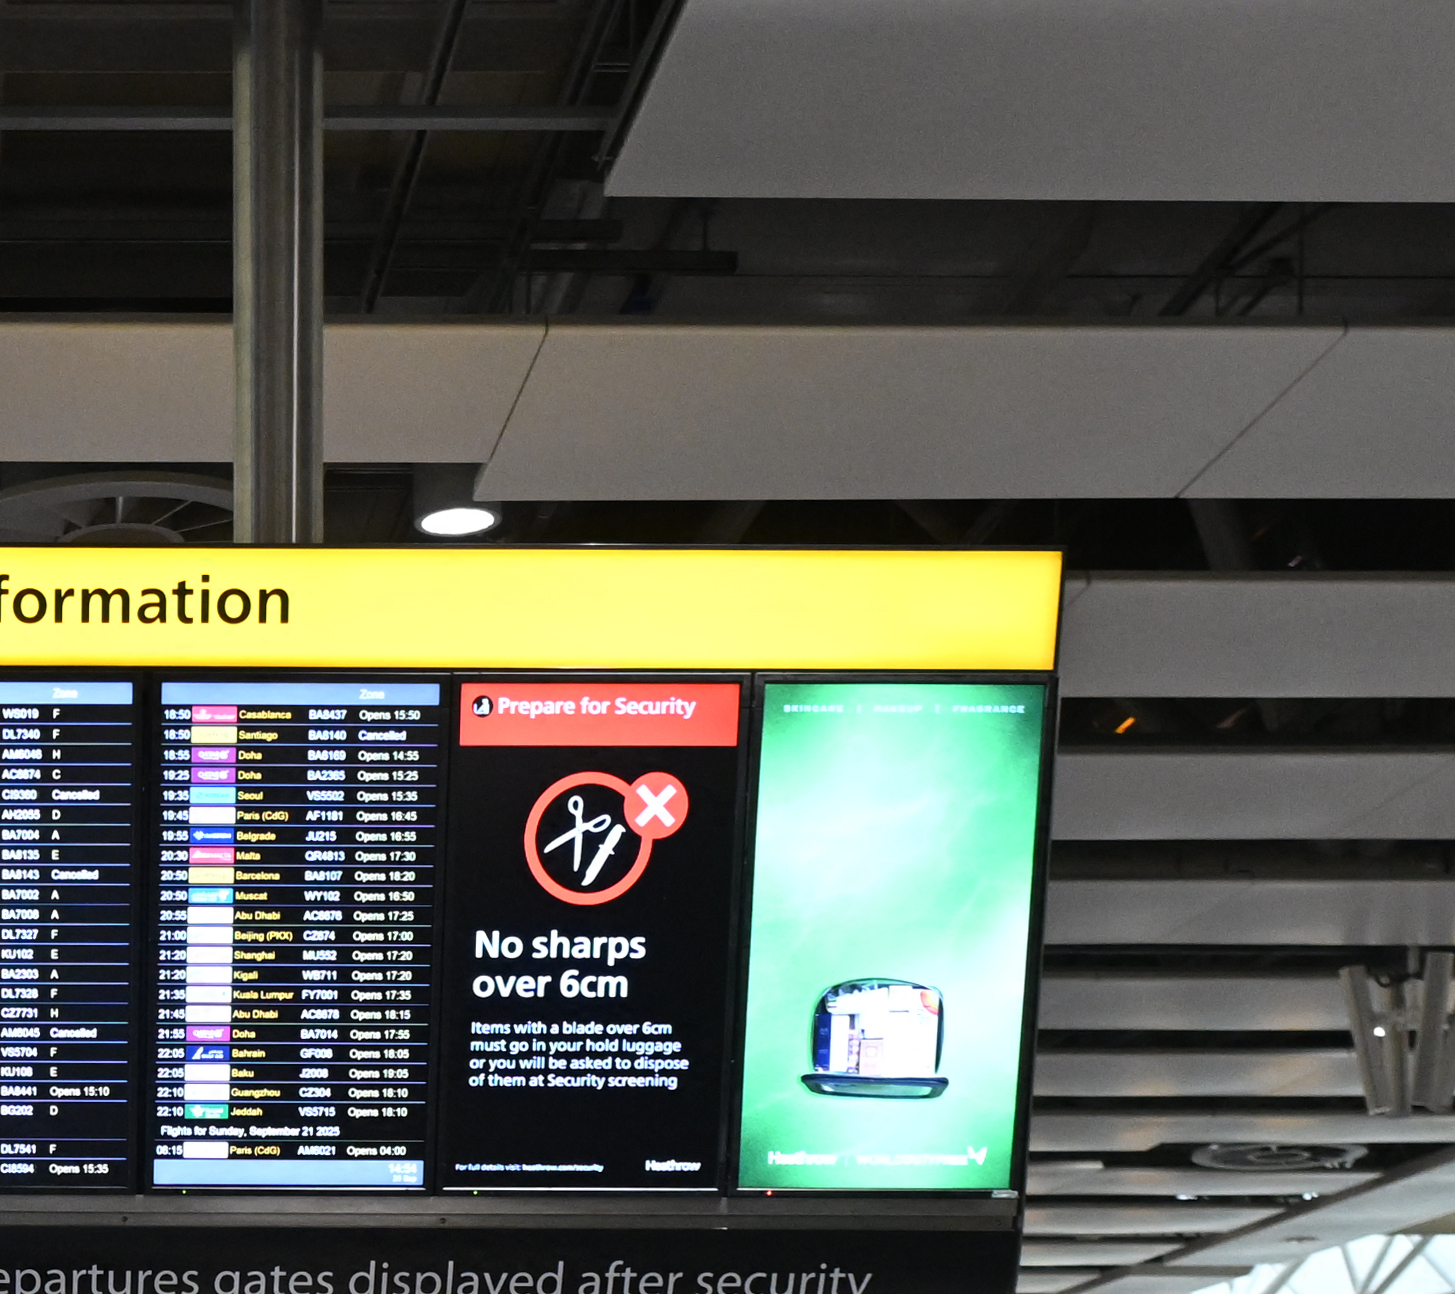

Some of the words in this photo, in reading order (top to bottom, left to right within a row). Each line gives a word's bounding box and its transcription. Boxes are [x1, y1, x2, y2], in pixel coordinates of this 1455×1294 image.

[498, 697, 575, 718] Prepare
[580, 697, 610, 714] for
[615, 697, 696, 719] Security
[476, 930, 523, 958] No
[532, 930, 646, 966] sharps
[473, 976, 552, 997] over
[560, 969, 628, 998] 6cm
[470, 1022, 511, 1034] Items
[514, 1021, 547, 1034] with
[563, 1021, 604, 1034] blade
[605, 1023, 641, 1035] over
[641, 1022, 673, 1034] 6cm
[470, 1039, 507, 1051] must
[509, 1041, 529, 1054] go
[532, 1039, 547, 1051] in
[549, 1041, 583, 1054] your
[586, 1039, 619, 1052] hold
[622, 1039, 681, 1055] luggage
[469, 1058, 487, 1070] or
[489, 1059, 516, 1072] you
[519, 1056, 545, 1069] will
[549, 1056, 567, 1069] be
[569, 1057, 613, 1069] asked
[634, 1056, 689, 1072] dispose
[469, 1073, 485, 1086] of
[487, 1074, 527, 1086] them
[528, 1075, 545, 1086] at
[547, 1074, 605, 1090] Security
[608, 1074, 677, 1090] screening
[644, 1160, 702, 1171] Heathrow
[769, 1151, 838, 1165] Heathrow
